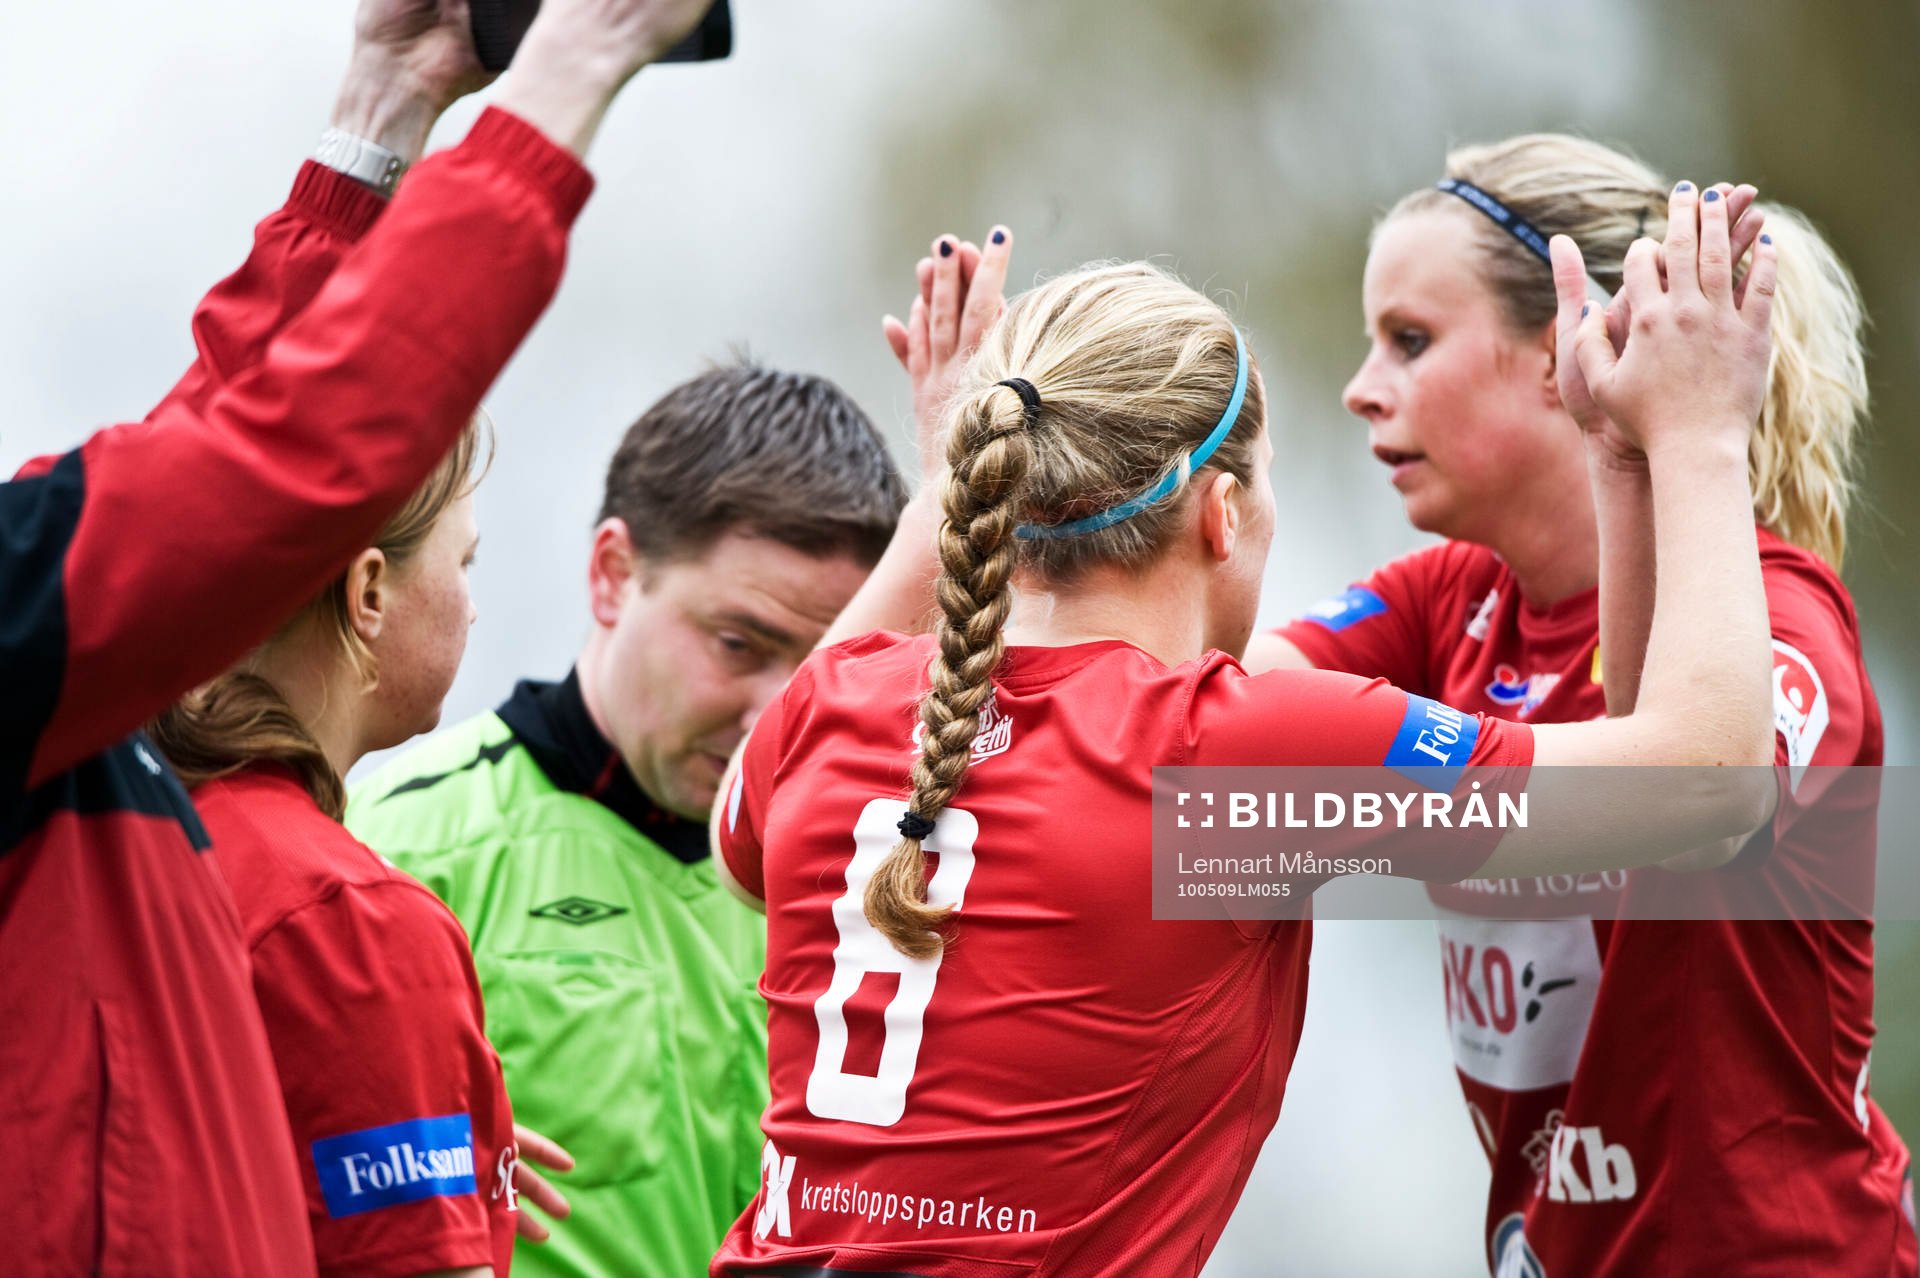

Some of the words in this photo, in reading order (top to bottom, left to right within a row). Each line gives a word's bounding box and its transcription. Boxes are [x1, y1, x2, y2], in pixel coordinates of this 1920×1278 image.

[805, 797, 980, 1127] 8
[340, 1142, 475, 1196] Folksam
[800, 1177, 1038, 1234] kretsloppsparken
